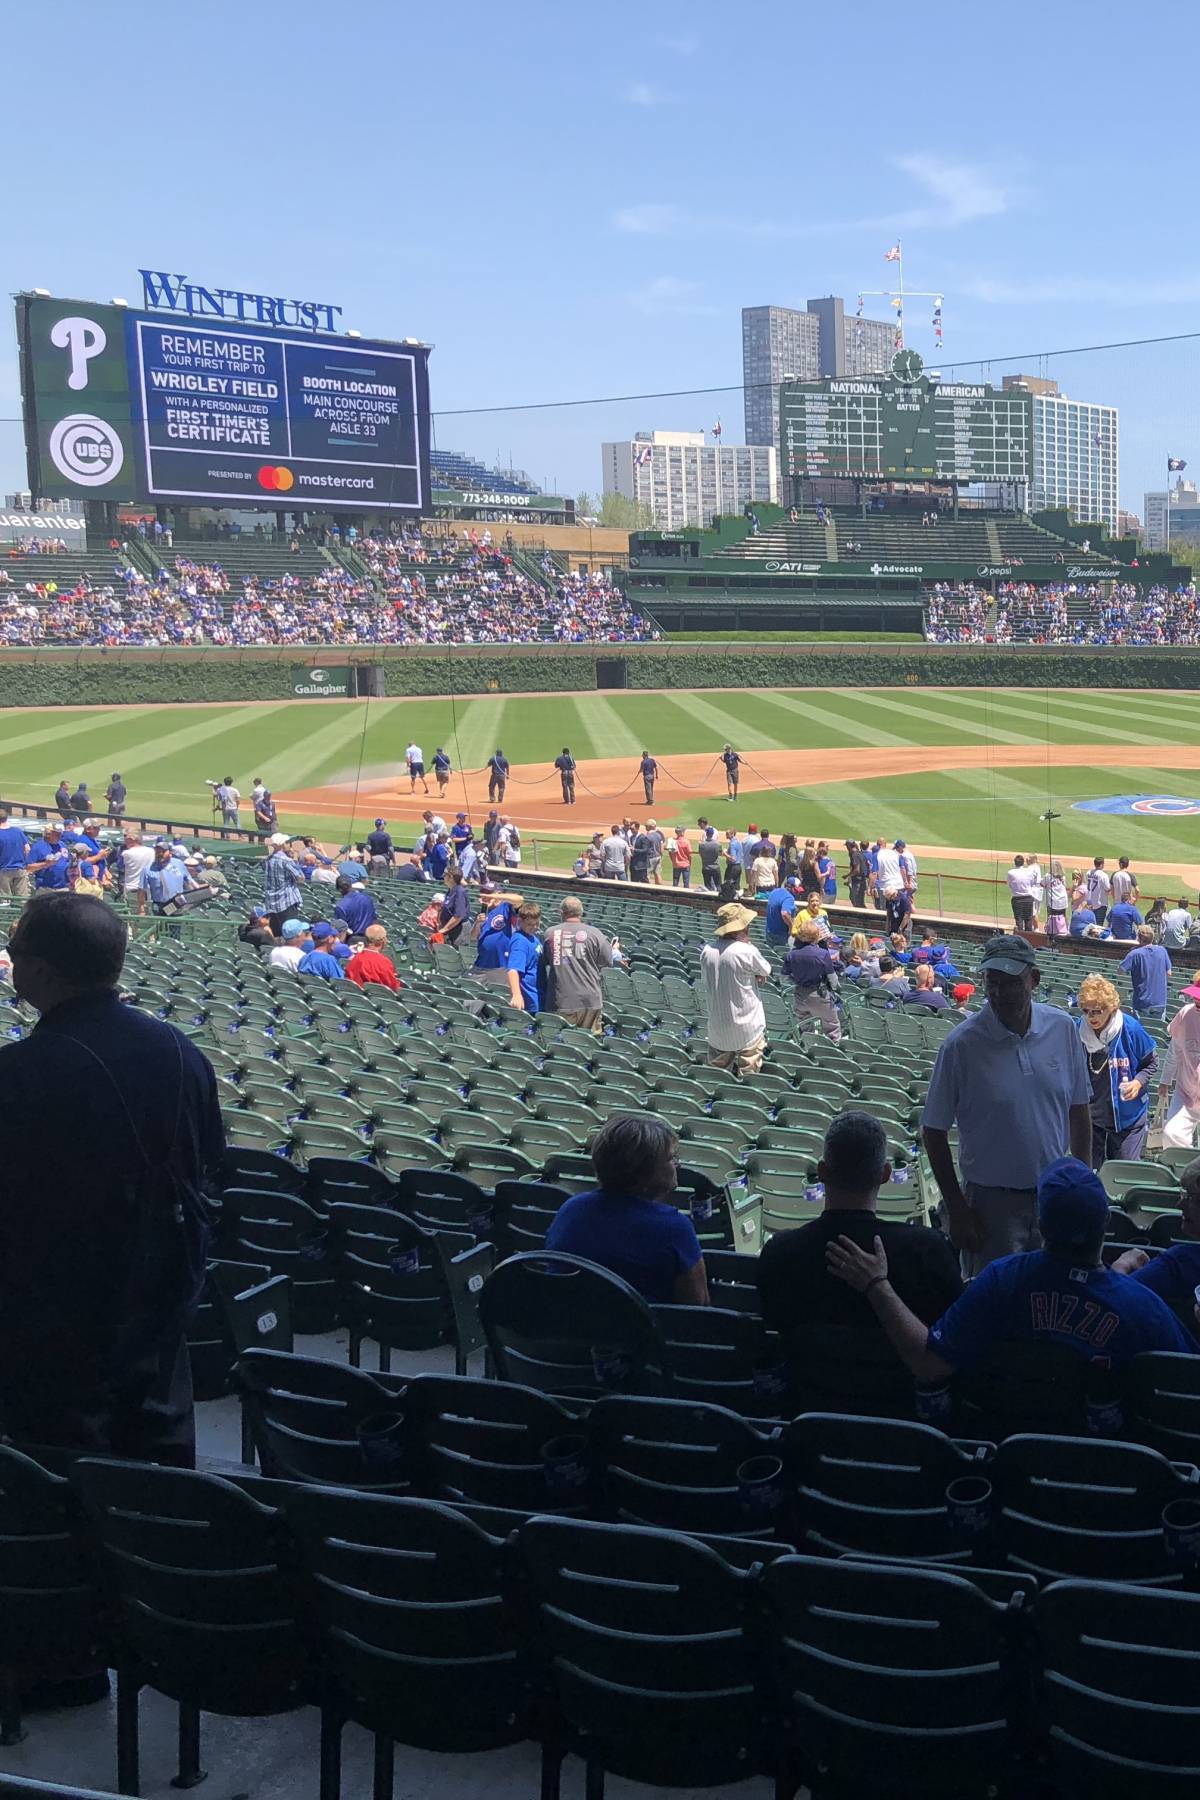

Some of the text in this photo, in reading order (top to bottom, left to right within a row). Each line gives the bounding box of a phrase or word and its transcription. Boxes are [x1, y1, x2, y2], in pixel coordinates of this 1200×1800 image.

[137, 269, 342, 332] WINTRUST
[161, 334, 265, 362] REMEMBER
[163, 353, 265, 375] YOUR FIRST TRIP TO
[151, 371, 278, 398] WRIGLEY FIELD
[303, 376, 396, 397] BOOTH LOCATION
[830, 382, 882, 394] NATIONAL
[934, 386, 985, 397] AMERICAN
[165, 396, 268, 415] WITH A PERSONALIZED
[303, 394, 398, 414] MAIN CONCOURSE
[897, 403, 920, 411] BATTER
[167, 409, 270, 430] FIRST TIMER'S
[314, 408, 390, 425] ACROSS FROM
[167, 423, 271, 445] CERTIFICATE
[330, 422, 376, 436] AISLE 33
[208, 470, 242, 480] PRESENTED
[299, 474, 374, 489] mastercard
[462, 493, 530, 506] 773-248-ROOF
[779, 562, 802, 571] ATI
[882, 564, 923, 573] Advocate
[989, 567, 1012, 576] pepsi
[1066, 566, 1120, 578] Budweiser
[294, 683, 347, 696] Gallagher
[1030, 1291, 1120, 1348] RIZZO
